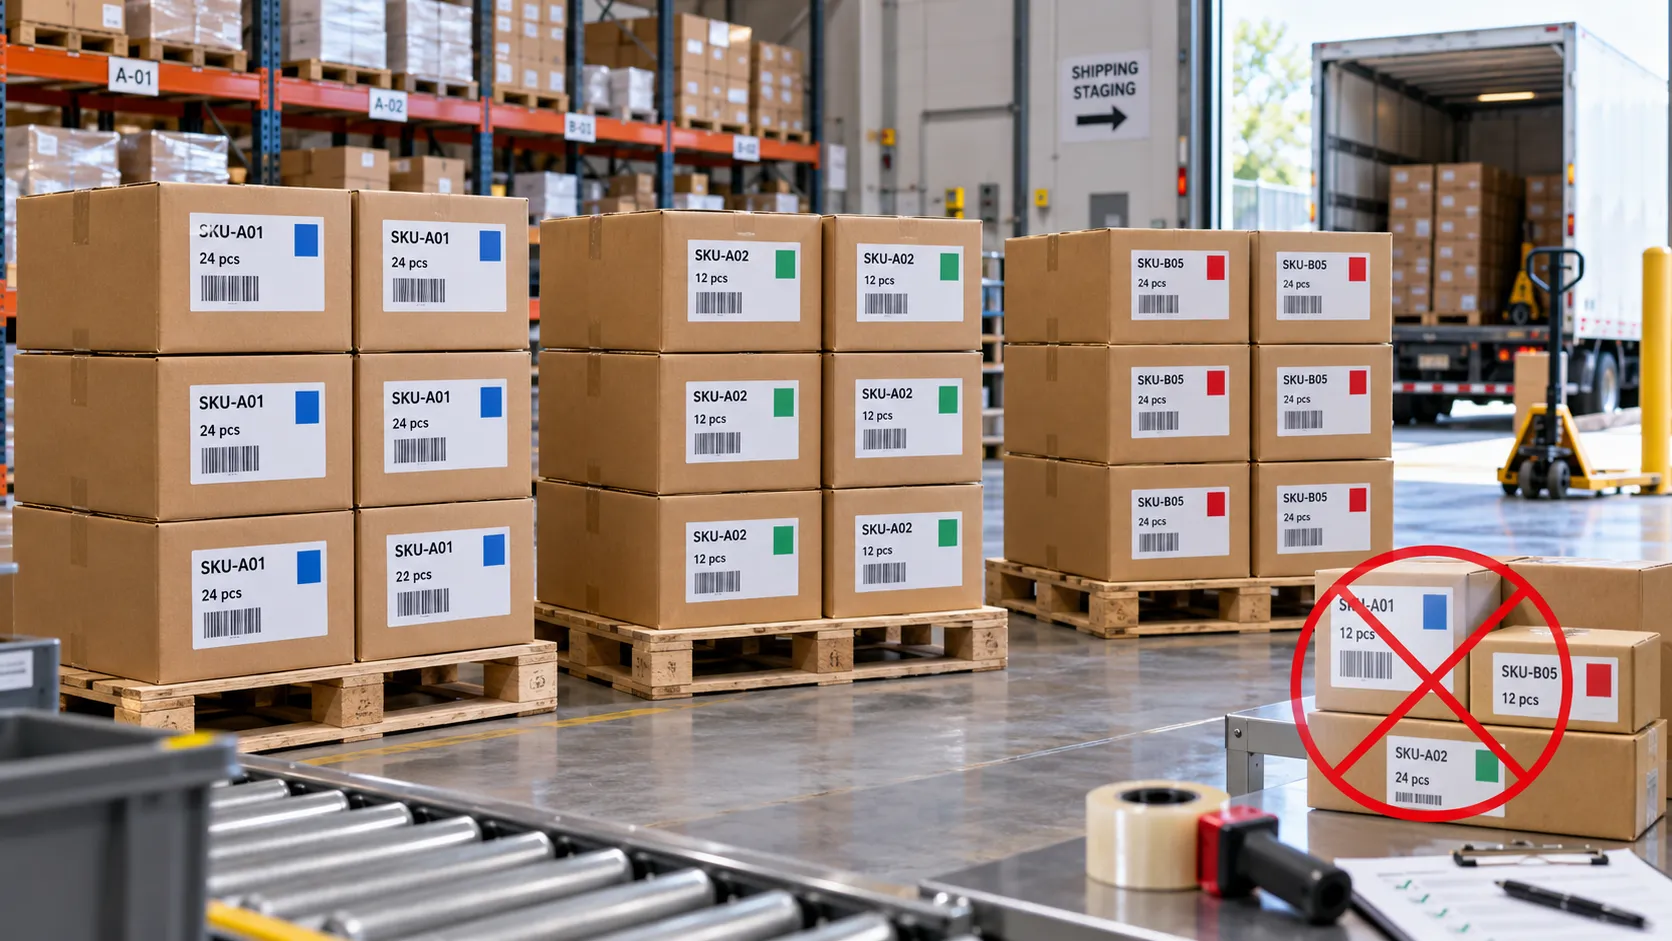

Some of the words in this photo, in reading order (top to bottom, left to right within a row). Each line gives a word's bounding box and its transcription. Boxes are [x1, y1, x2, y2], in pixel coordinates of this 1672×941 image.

[115, 66, 152, 86] A-01
[1072, 61, 1139, 79] SHIPPING
[1073, 82, 1136, 100] STAGING
[374, 98, 403, 112] A-02
[199, 223, 263, 238] SKU-A01
[391, 230, 449, 244] SKU-A01
[199, 251, 215, 264] 24
[218, 255, 240, 267] pcs
[694, 248, 749, 261] SKU-A02
[863, 252, 915, 264] SKU-A02
[391, 256, 405, 268] 24
[409, 259, 427, 270] pcs
[1137, 257, 1184, 268] SKU-B05
[1282, 259, 1327, 269] SKU-B05
[695, 272, 707, 282] 12
[710, 275, 728, 285] pcs
[864, 274, 875, 284] 12
[878, 277, 894, 287] pcs
[1137, 278, 1148, 287] 24
[1151, 280, 1166, 289] pcs
[1283, 279, 1293, 288] 24
[1295, 281, 1310, 290] pcs
[1137, 374, 1184, 385] SKU-B05
[1283, 374, 1328, 384] SKU-B05
[392, 390, 450, 404] SKU-A01
[693, 389, 748, 402] SKU-A02
[862, 387, 913, 399] SKU-A02
[1283, 394, 1293, 403] 24
[1296, 396, 1310, 405] pcs
[199, 394, 263, 409] SKU-A01
[1138, 395, 1148, 404] 24
[1151, 396, 1166, 406] pcs
[694, 413, 706, 424] 12
[708, 415, 726, 426] pcs
[862, 410, 873, 420] 12
[876, 412, 892, 422] pcs
[392, 417, 405, 429] 24
[409, 419, 428, 431] pcs
[199, 424, 214, 436] 24
[219, 426, 240, 438] pcs
[1137, 495, 1184, 507] SKU-B05
[1283, 491, 1328, 503] SKU-B05
[1138, 517, 1149, 526] 24
[1151, 518, 1166, 527] pcs
[1283, 512, 1294, 521] 24
[1296, 514, 1310, 523] pcs
[861, 521, 913, 535] SKU-A02
[693, 528, 747, 542] SKU-A02
[395, 540, 452, 557] SKU-A01
[862, 545, 873, 556] 12
[876, 546, 892, 557] pcs
[200, 556, 265, 574] SKU-A01
[693, 553, 705, 564] 12
[708, 555, 726, 565] pcs
[395, 570, 409, 582] 22
[413, 571, 432, 583] pcs
[201, 588, 217, 601] 24
[221, 589, 241, 602] pcs
[1340, 627, 1353, 639] 12
[1356, 630, 1375, 642] pcs
[1501, 664, 1558, 679] SKU-B05
[1502, 691, 1515, 704] 12
[1518, 695, 1539, 707] pcs
[1395, 746, 1448, 762] SKU-A02
[1395, 771, 1408, 783] 24
[1411, 775, 1429, 786] pcs
